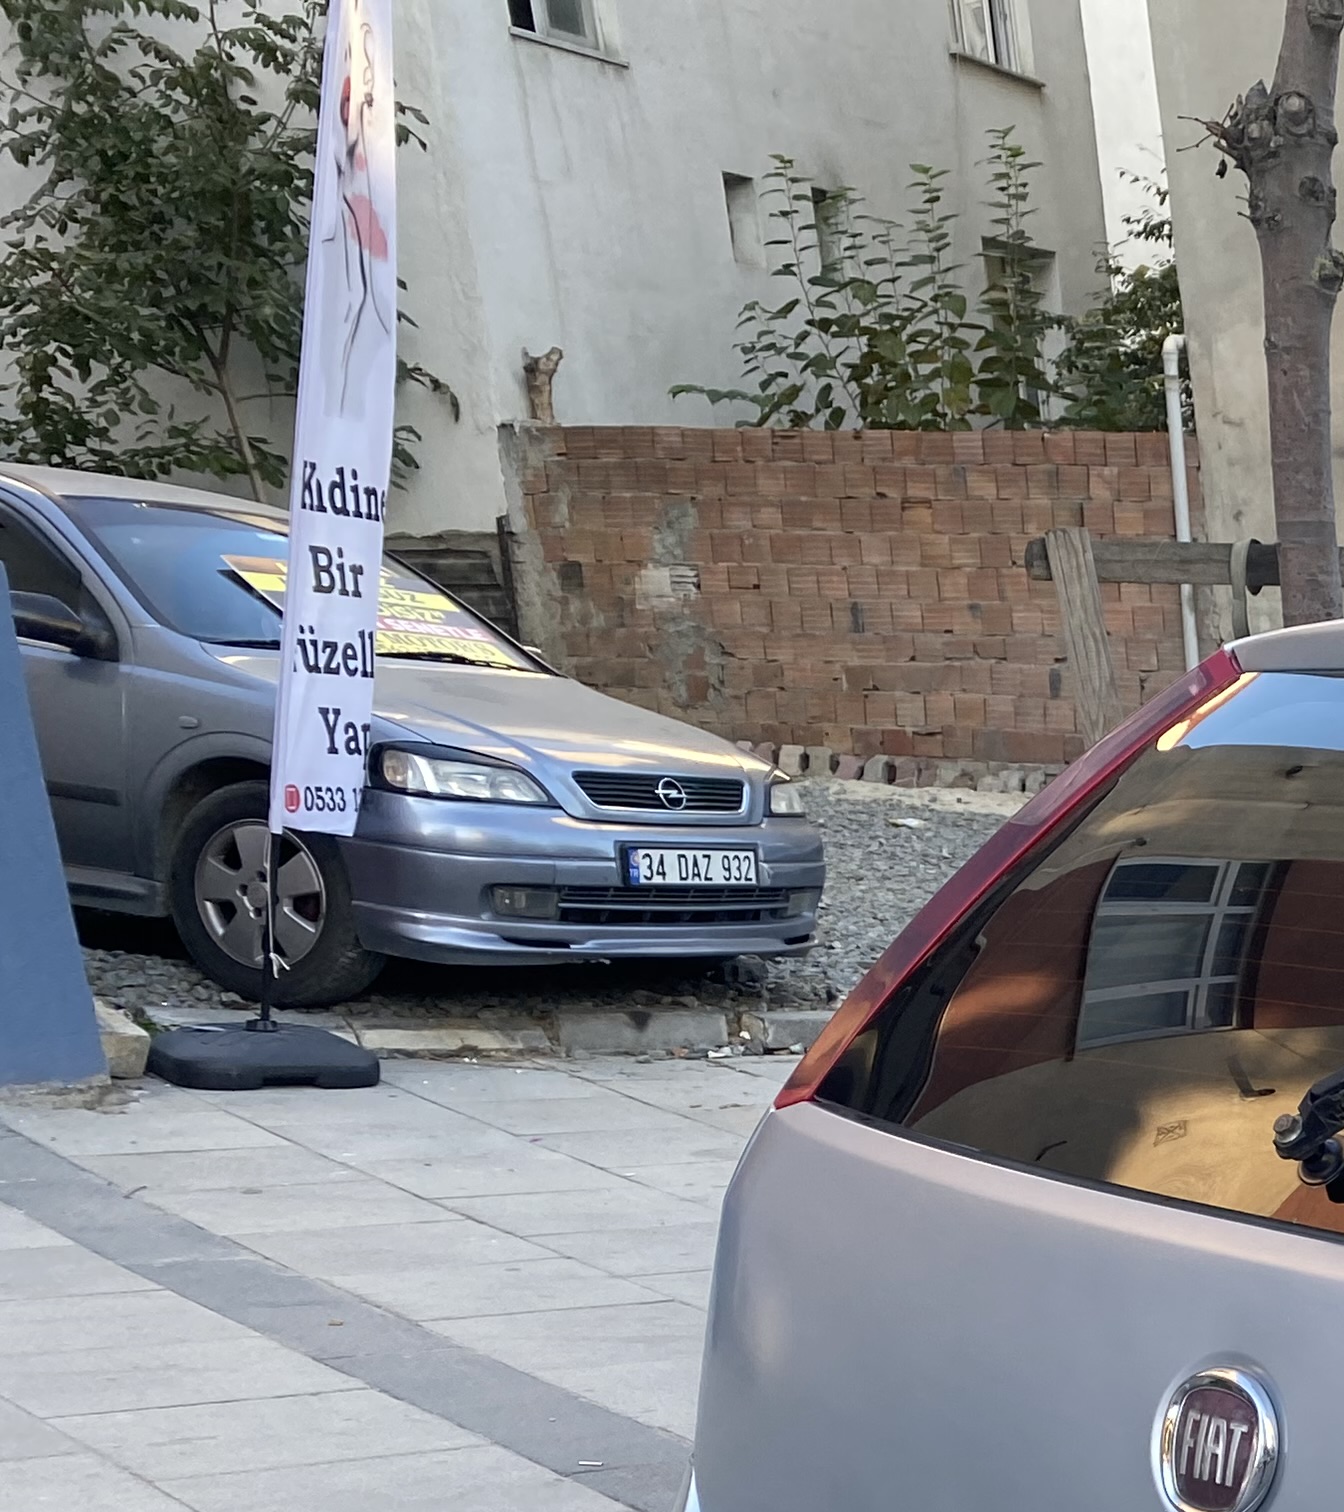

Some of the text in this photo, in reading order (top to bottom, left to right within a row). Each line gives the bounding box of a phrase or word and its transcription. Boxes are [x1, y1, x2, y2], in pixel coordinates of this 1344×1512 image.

[308, 545, 364, 598] Bir
[304, 786, 346, 812] 0533
[641, 853, 753, 882] 34 DAZ 932
[1179, 1409, 1249, 1487] FIAT
